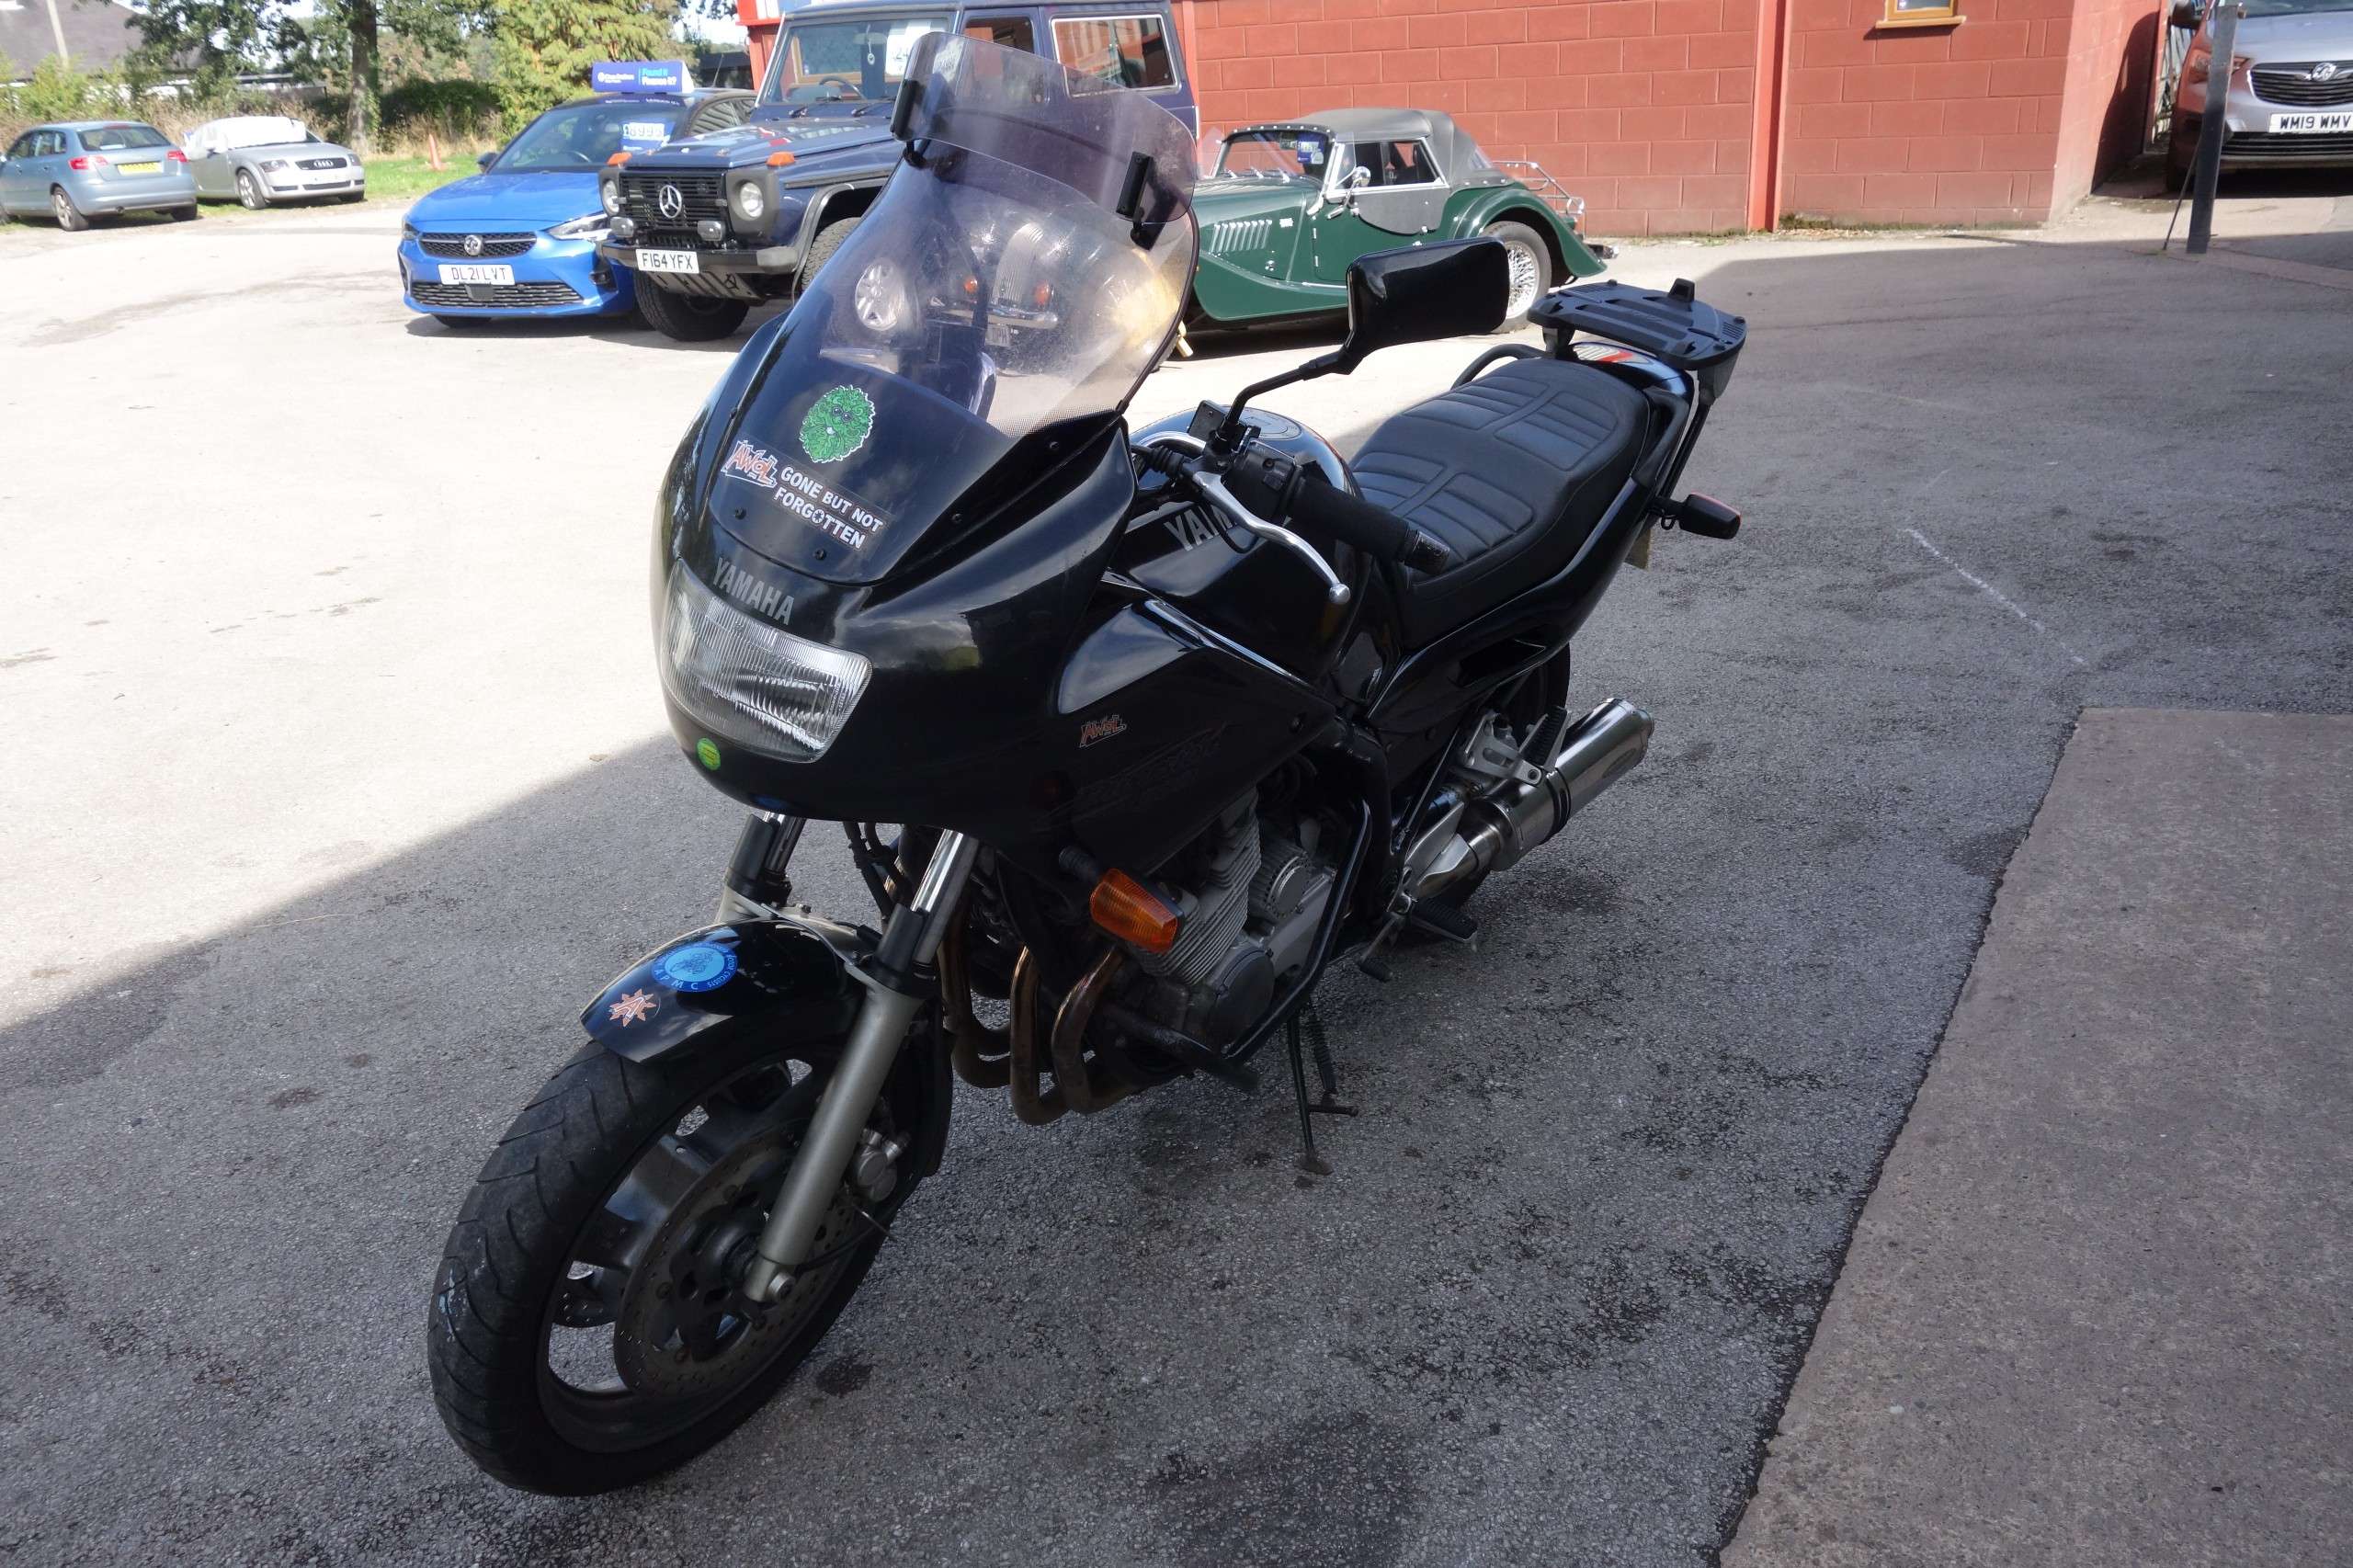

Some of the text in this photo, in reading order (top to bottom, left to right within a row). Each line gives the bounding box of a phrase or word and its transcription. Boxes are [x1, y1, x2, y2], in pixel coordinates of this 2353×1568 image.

[2279, 115, 2352, 130] WM19 WMV
[451, 267, 506, 280] DL21 LVT
[642, 253, 693, 270] F164 YFX
[774, 486, 866, 549] FORGOTTEN
[780, 466, 883, 532] GONE BUT NOT
[1164, 504, 1237, 551] YAM
[713, 557, 794, 625] YAMAHA
